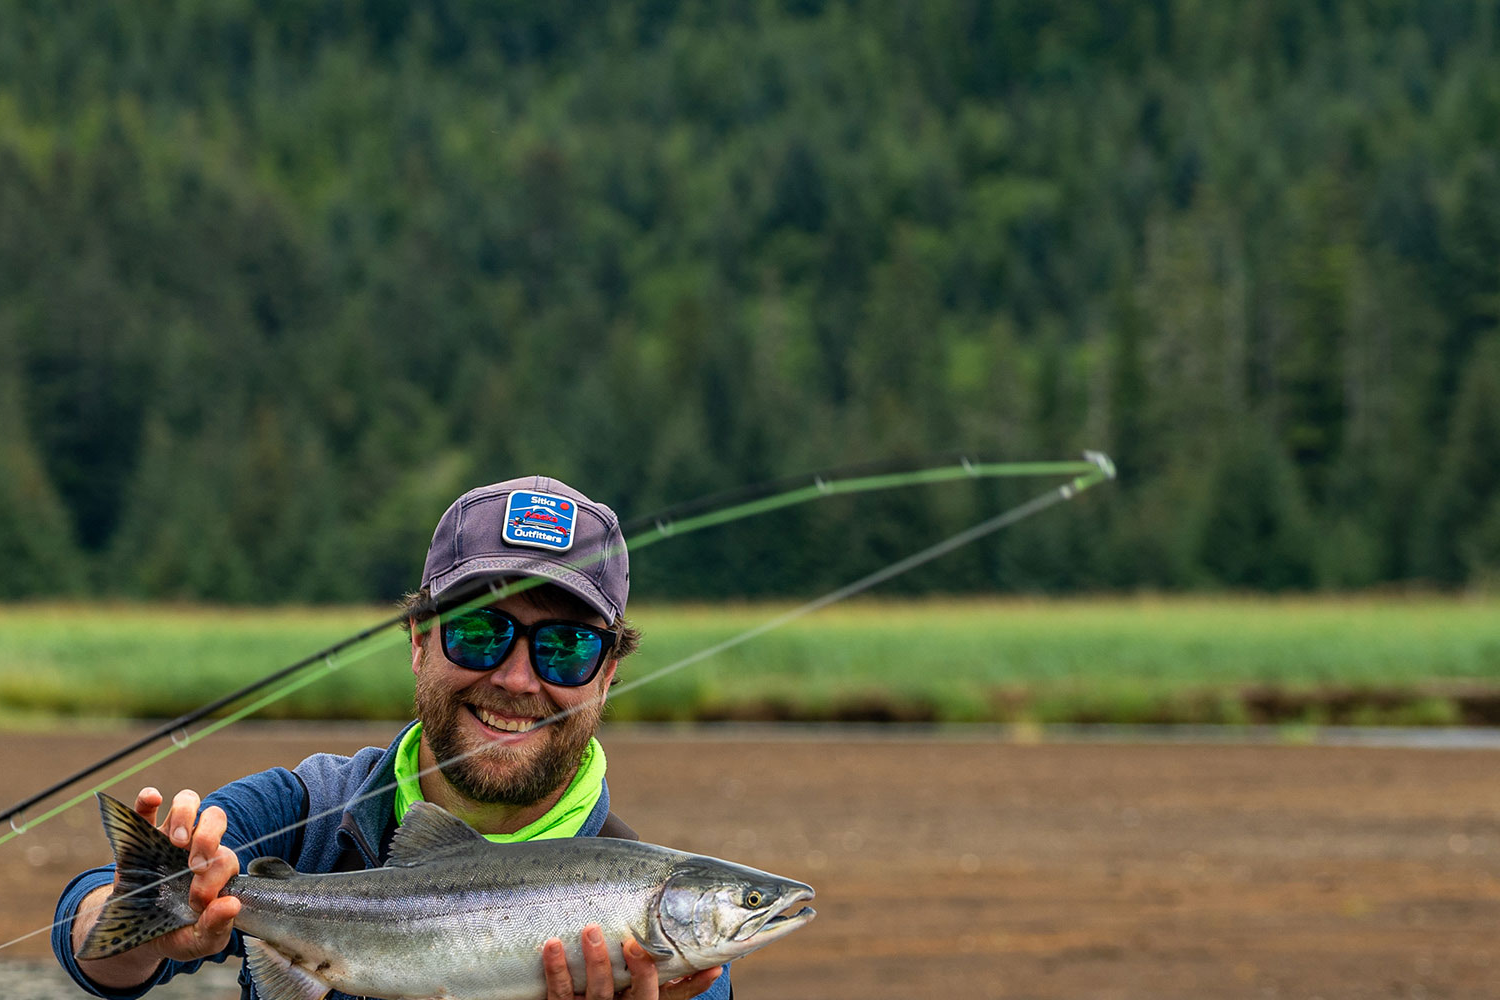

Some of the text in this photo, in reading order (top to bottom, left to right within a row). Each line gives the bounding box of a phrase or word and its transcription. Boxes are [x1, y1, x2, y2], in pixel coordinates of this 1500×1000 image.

[530, 495, 556, 507] Sitka
[524, 510, 558, 523] Alaska
[514, 528, 562, 543] Outfitters
